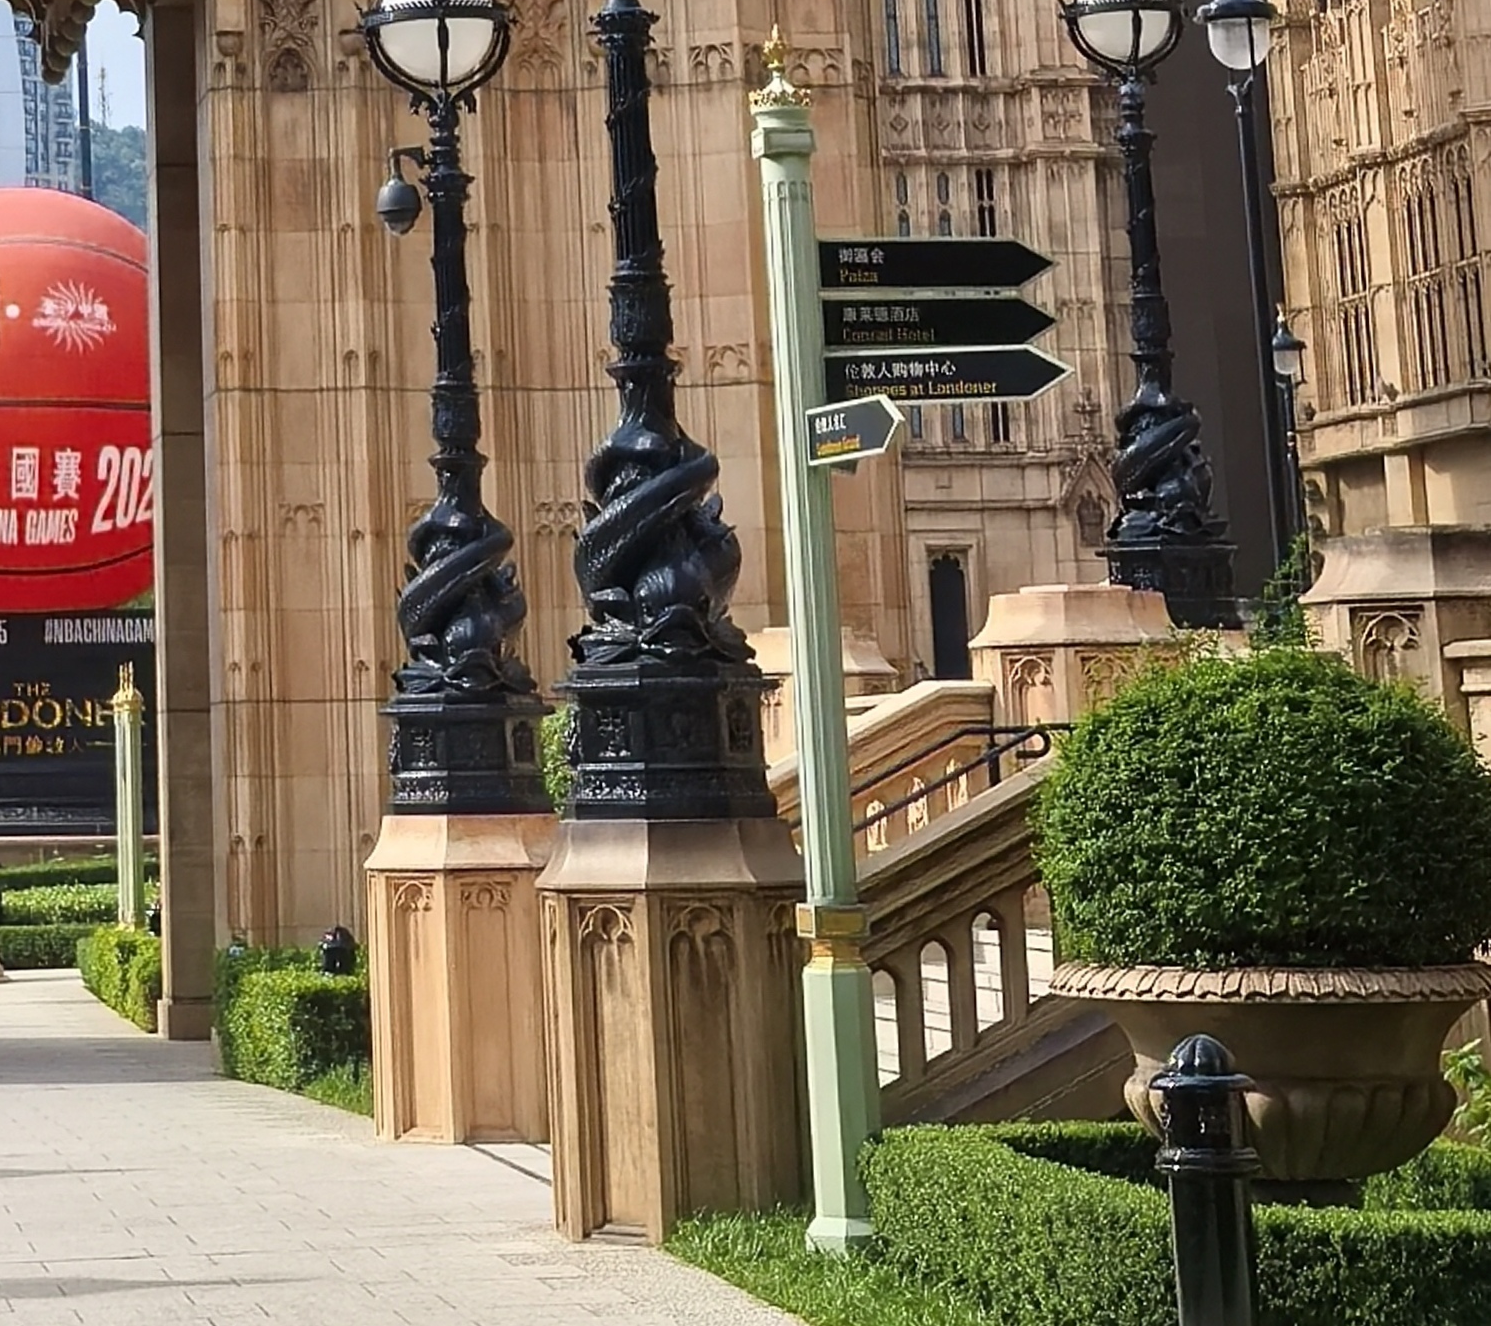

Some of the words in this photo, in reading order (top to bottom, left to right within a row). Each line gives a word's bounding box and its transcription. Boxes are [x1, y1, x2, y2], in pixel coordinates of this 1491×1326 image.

[845, 359, 957, 380] 伦敦人购物中心
[911, 383, 924, 395] at
[928, 380, 998, 395] Londoner
[25, 509, 80, 546] GAMES
[13, 682, 52, 697] THE
